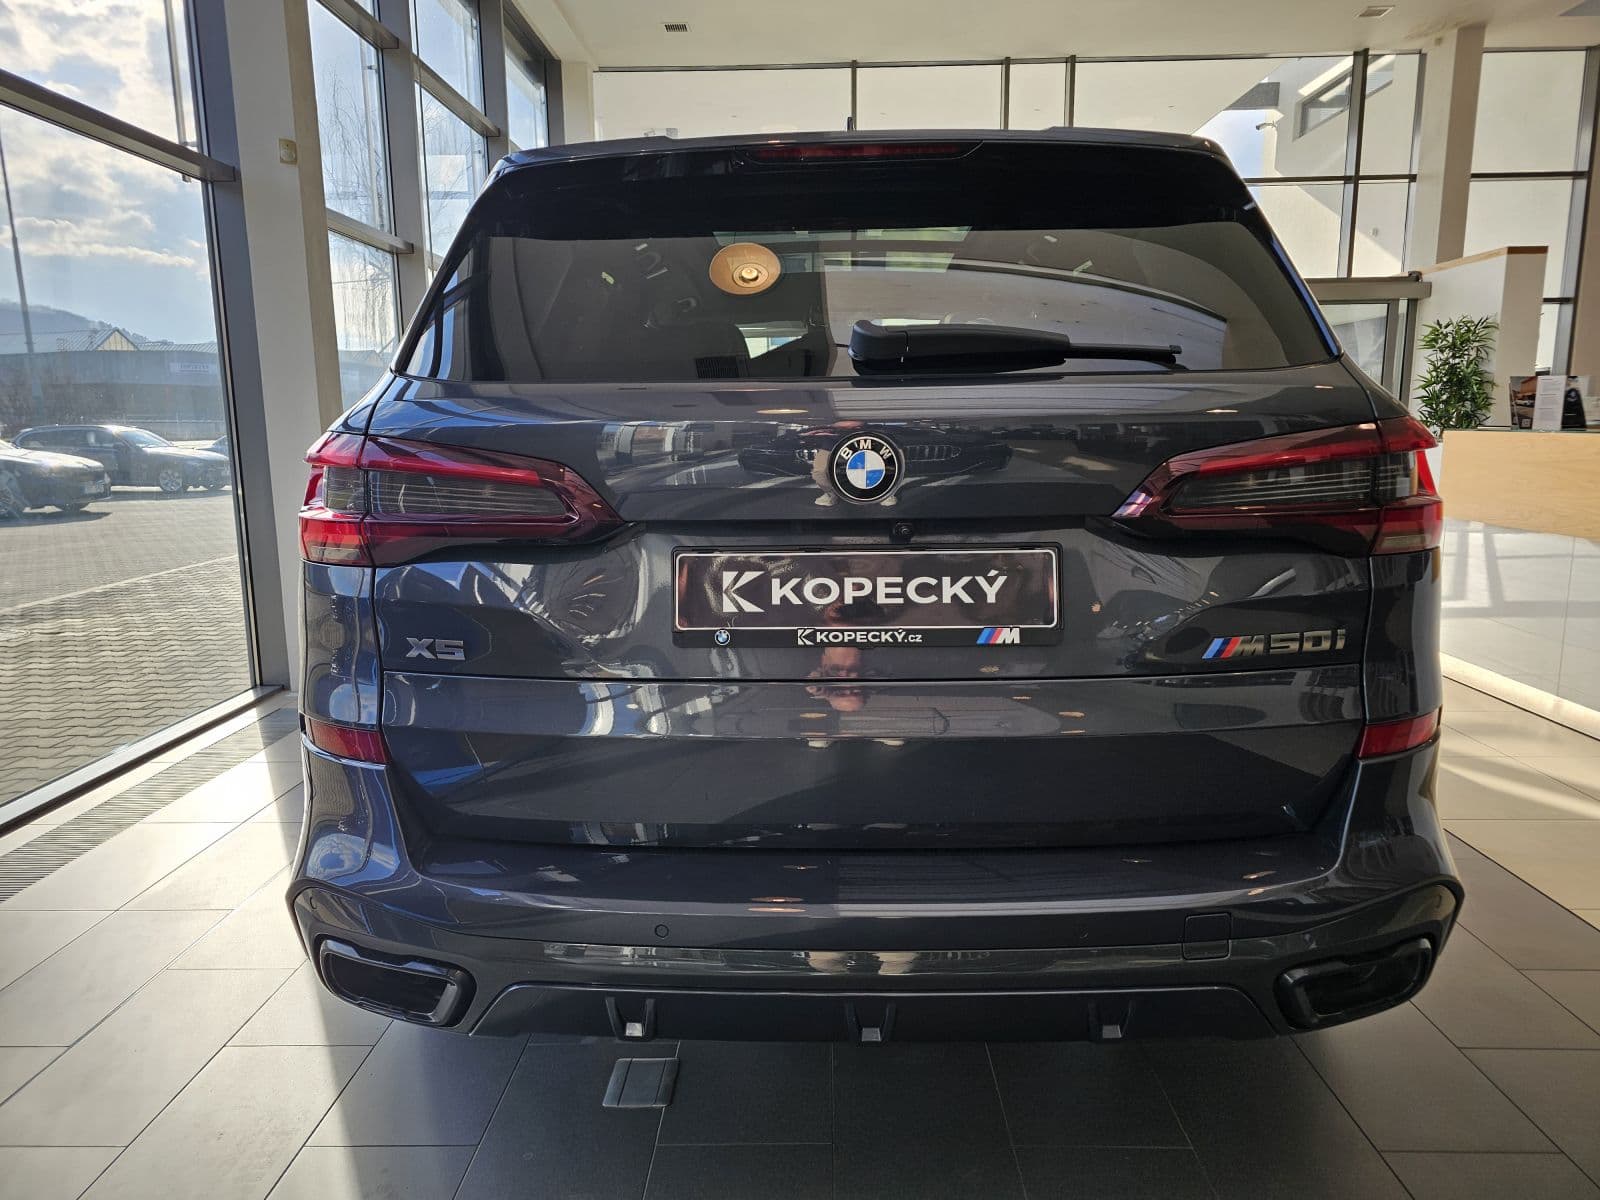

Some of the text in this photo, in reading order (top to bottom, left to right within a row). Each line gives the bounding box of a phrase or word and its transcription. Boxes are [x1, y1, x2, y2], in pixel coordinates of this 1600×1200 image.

[840, 439, 892, 460] BMW
[771, 569, 1008, 606] KOPECKÝ
[816, 629, 923, 645] KOPECKÝ.cz
[405, 637, 466, 661] X5
